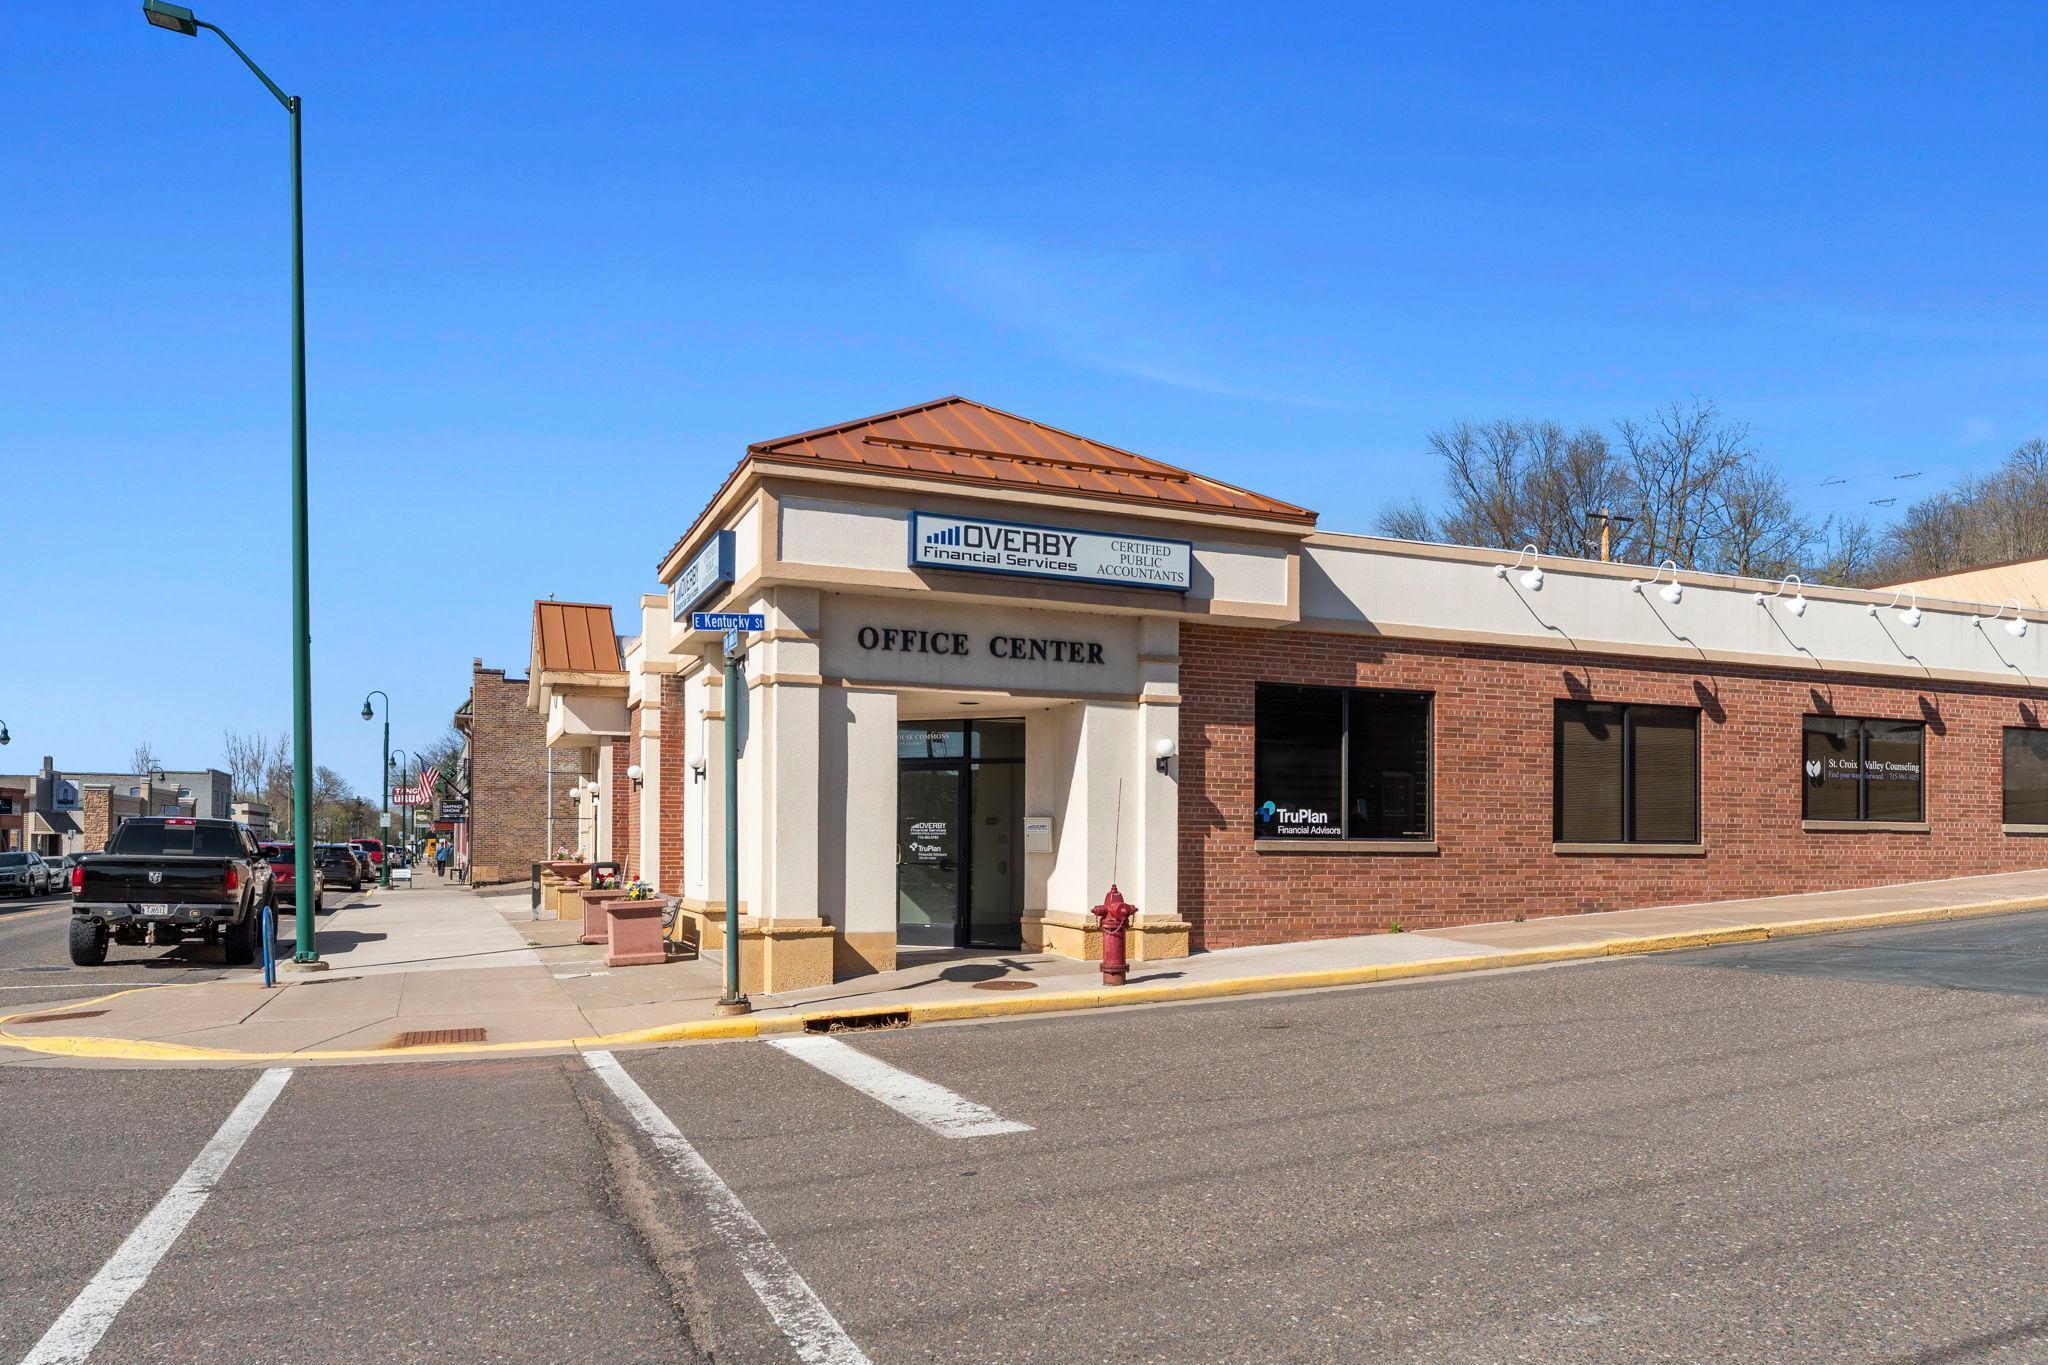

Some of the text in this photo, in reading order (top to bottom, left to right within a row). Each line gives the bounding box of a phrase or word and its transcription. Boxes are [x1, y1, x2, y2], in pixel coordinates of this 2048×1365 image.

[963, 524, 1078, 558] OVERBY
[1110, 541, 1172, 557] CERTIFIED
[924, 546, 1078, 572] Financial Services
[1120, 554, 1163, 568] PUBLIC
[1096, 563, 1185, 583] ACCOUNTANTS
[695, 614, 763, 630] E Kentucky St
[857, 626, 1105, 665] OFFICE CENTER
[1828, 758, 1920, 774] St. Croix Valley Counseling
[1277, 809, 1328, 824] TruPlan
[1278, 825, 1341, 835] Financial Advisors
[918, 843, 941, 852] TruPlan
